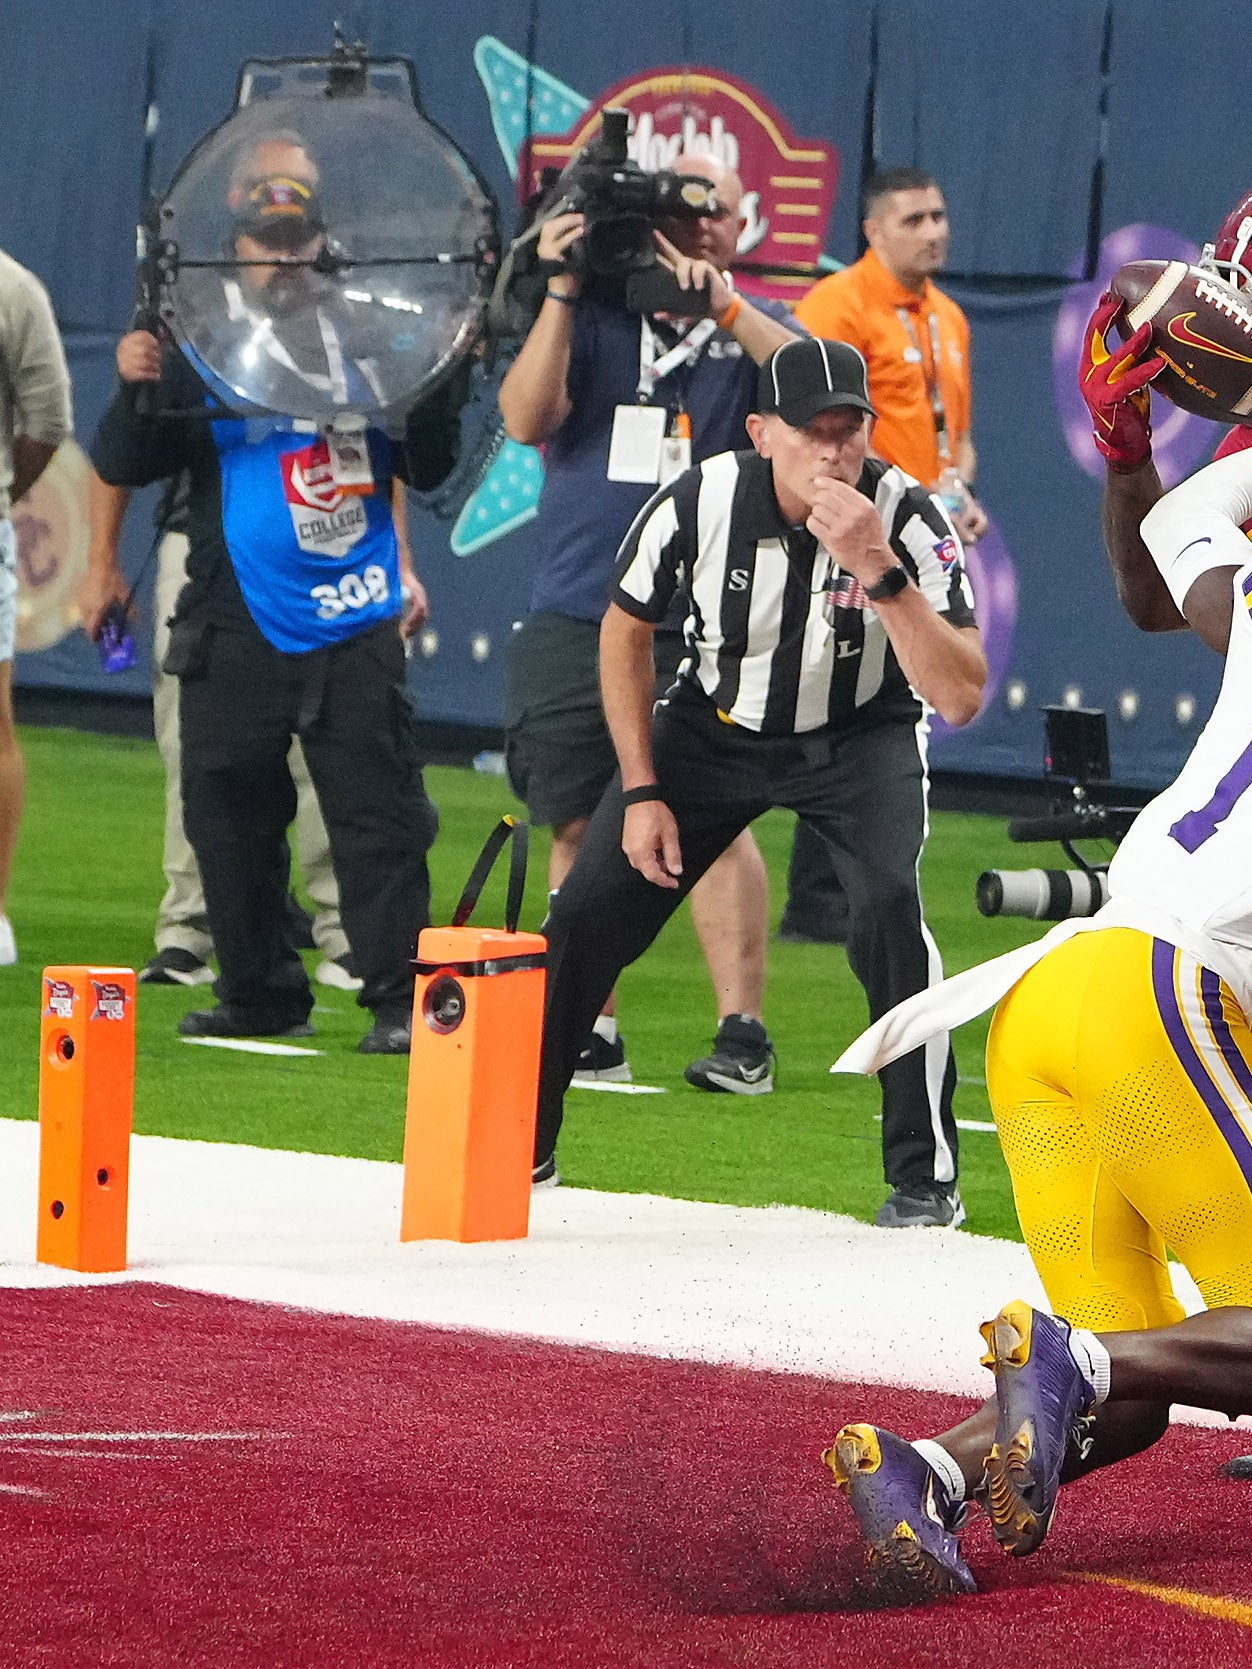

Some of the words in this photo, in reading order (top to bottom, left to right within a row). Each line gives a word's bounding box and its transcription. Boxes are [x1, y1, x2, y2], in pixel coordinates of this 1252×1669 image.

[299, 506, 364, 540] COLLEGE
[310, 564, 389, 620] 308
[728, 568, 749, 592] S
[836, 640, 862, 658] L
